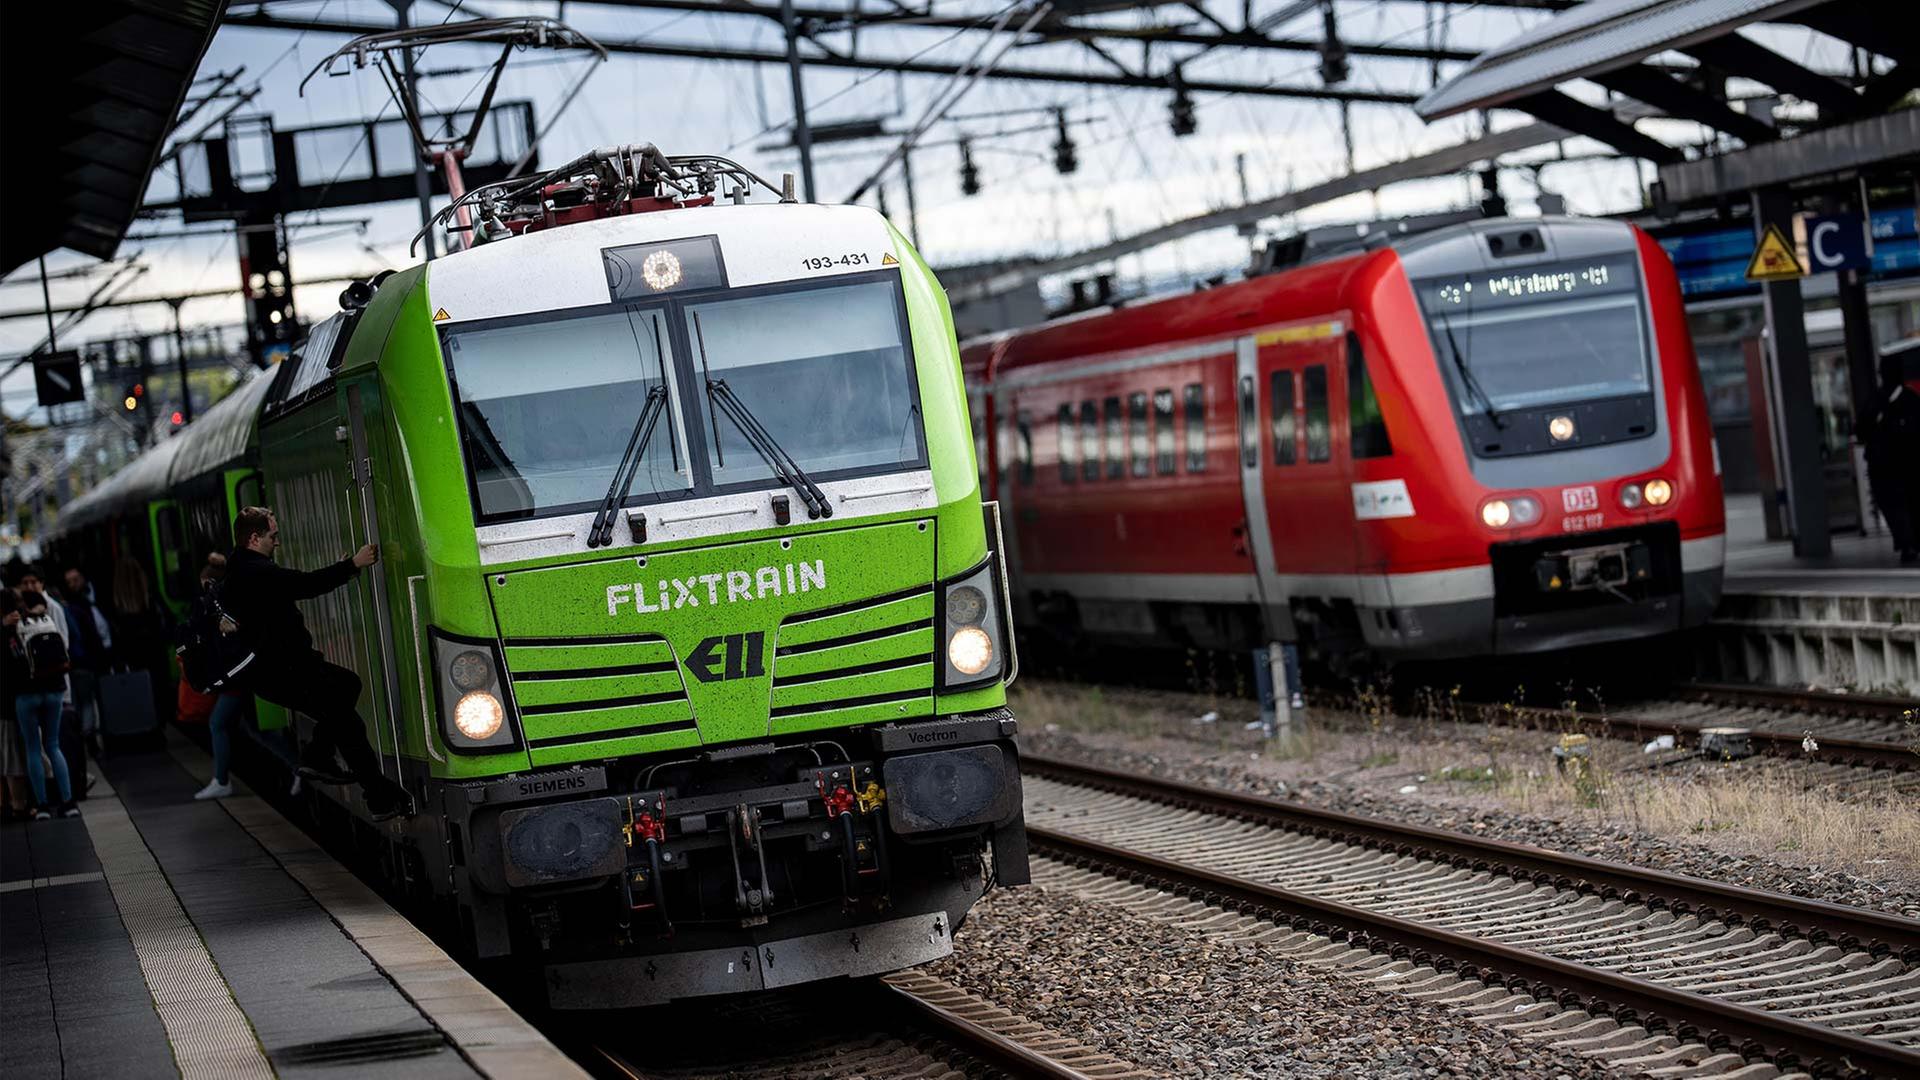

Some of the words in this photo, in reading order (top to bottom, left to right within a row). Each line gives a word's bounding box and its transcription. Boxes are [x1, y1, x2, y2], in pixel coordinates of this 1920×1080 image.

[1811, 221, 1845, 267] C
[802, 253, 869, 270] 193-431
[1565, 487, 1596, 509] DB
[907, 730, 958, 744] Vectron
[519, 776, 586, 796] SIEMENS
